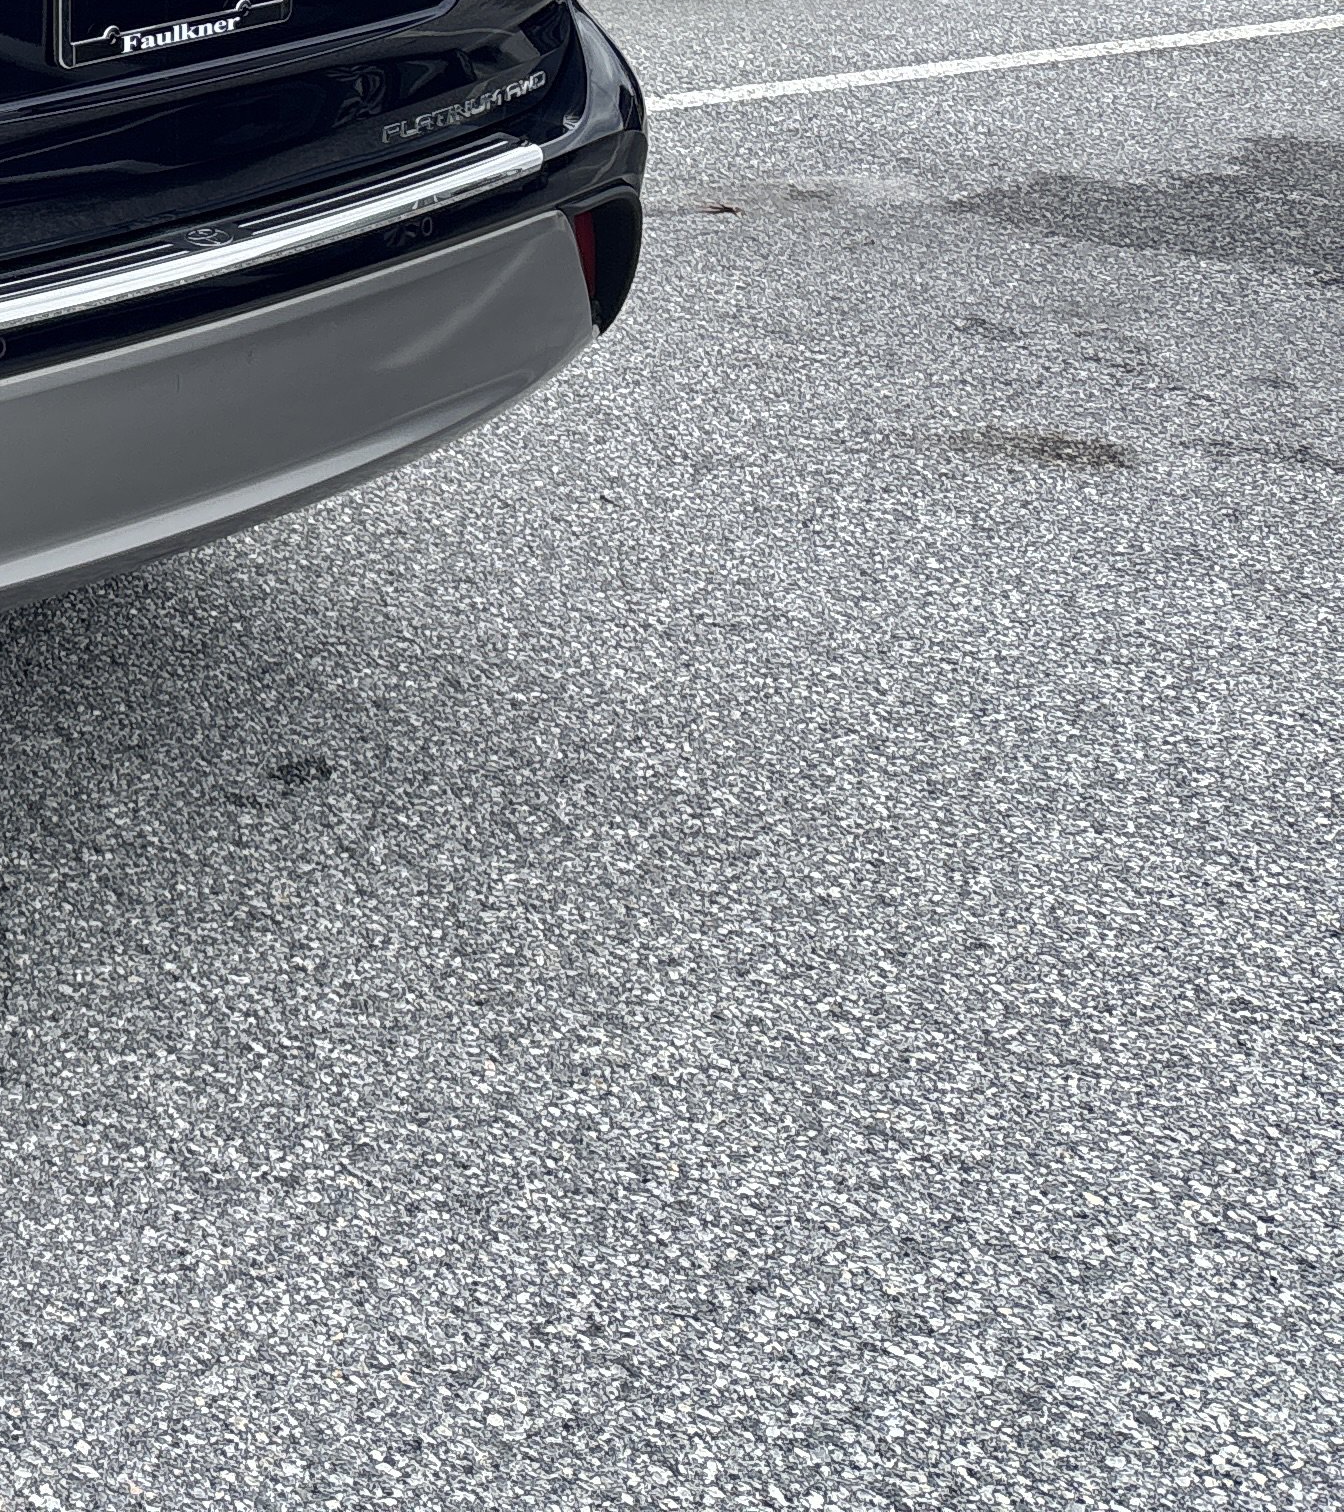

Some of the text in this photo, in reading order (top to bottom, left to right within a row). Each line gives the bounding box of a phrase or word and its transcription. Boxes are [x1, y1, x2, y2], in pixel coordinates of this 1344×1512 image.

[120, 16, 241, 53] Faulkner
[382, 70, 546, 143] PLATINUM AWD
